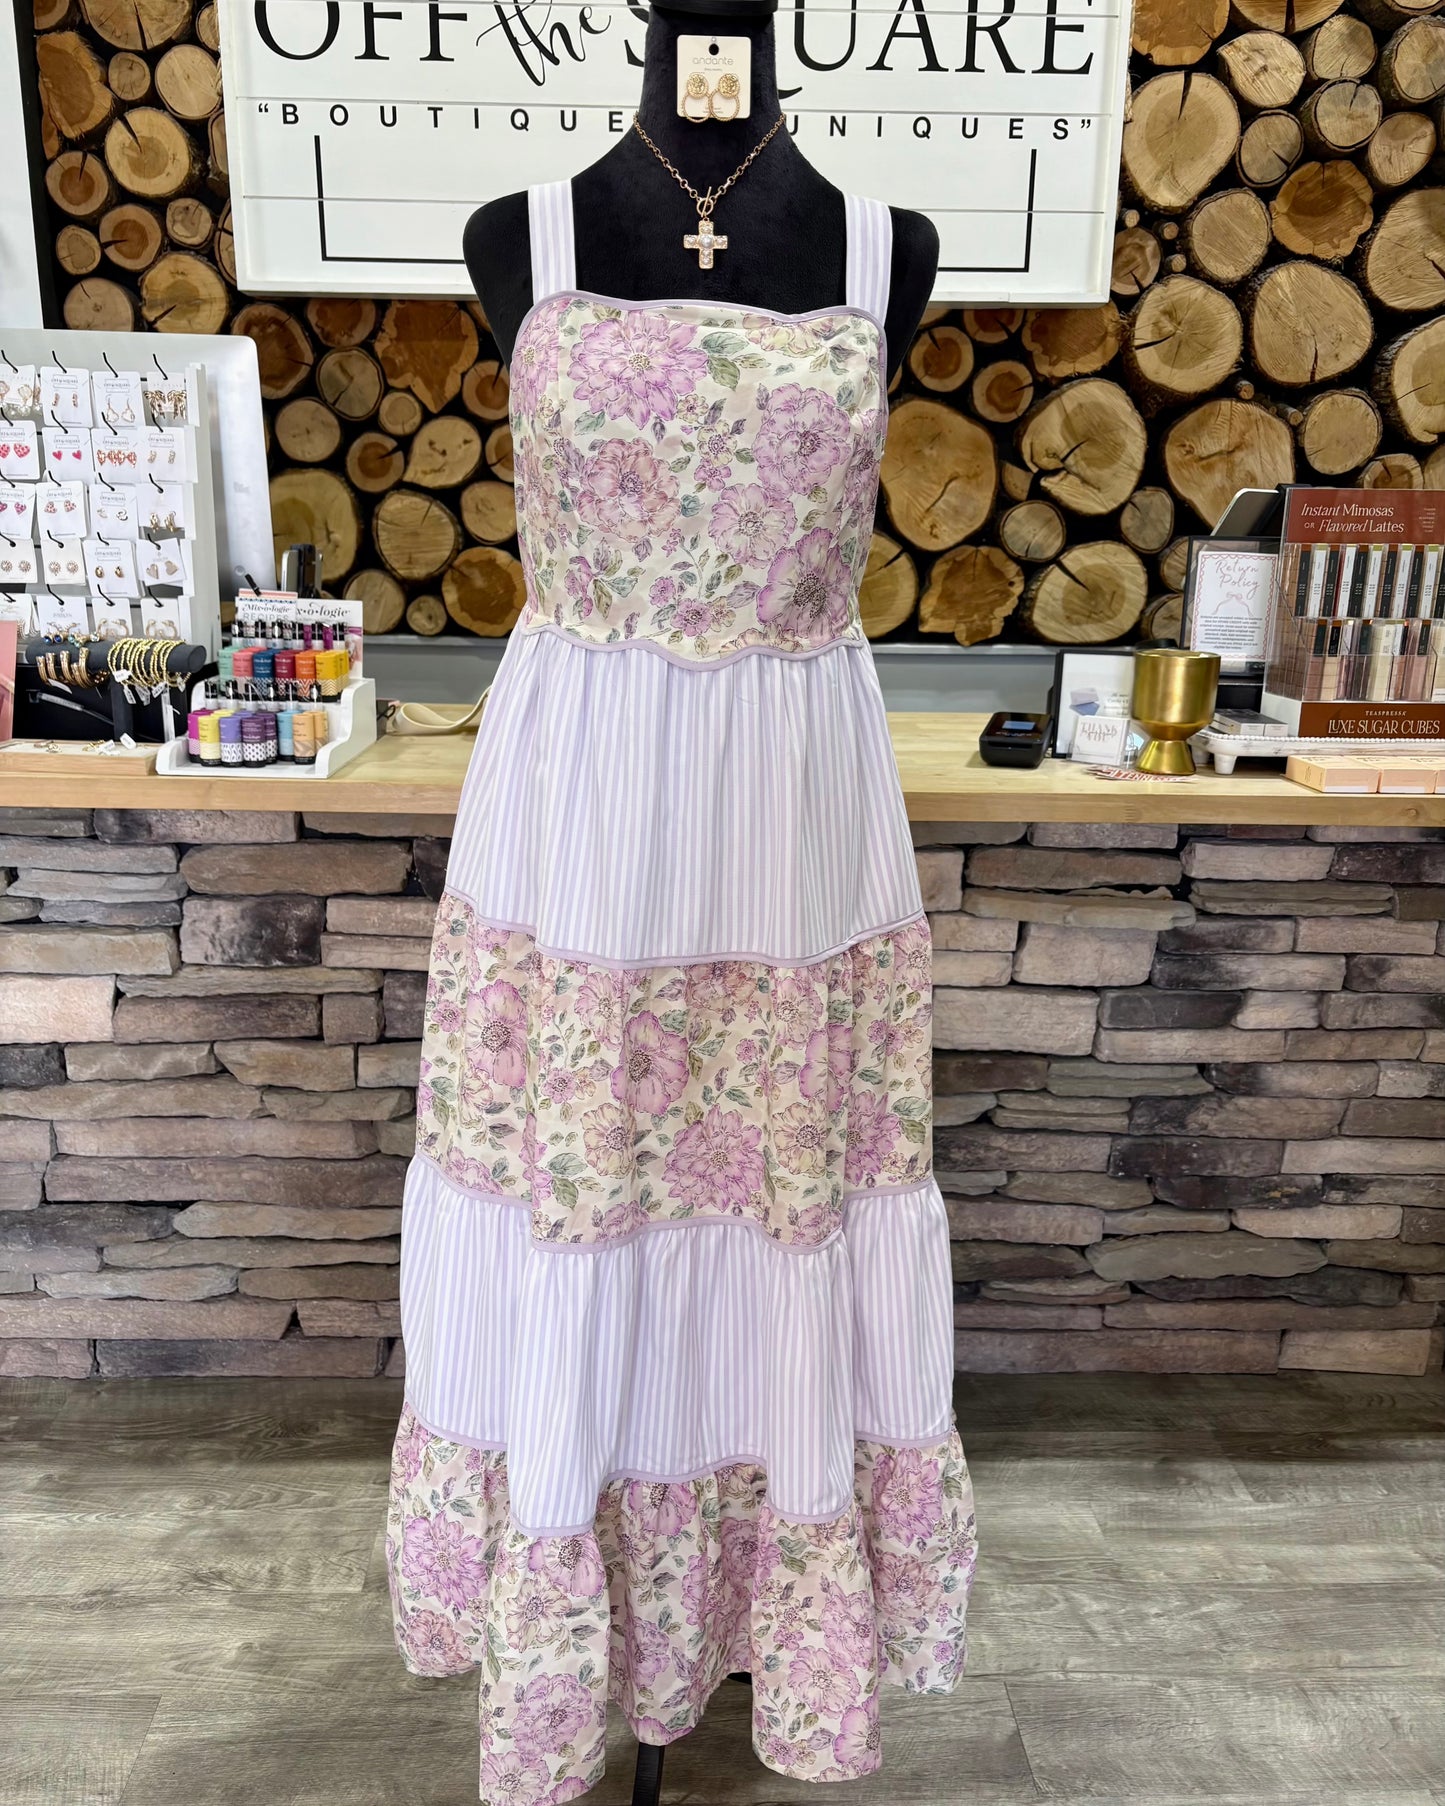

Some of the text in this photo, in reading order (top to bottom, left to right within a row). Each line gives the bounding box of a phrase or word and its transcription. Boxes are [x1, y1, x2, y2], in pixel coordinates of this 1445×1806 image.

[254, 0, 468, 61] OFF
[475, 0, 612, 87] the
[691, 56, 734, 66] andante
[1300, 503, 1395, 517] Instant Mimosas
[1303, 521, 1316, 529] OR
[1318, 519, 1369, 532] Flavored
[1369, 519, 1405, 533] Lattes
[1215, 559, 1260, 576] Return
[1219, 573, 1261, 600] Policy
[243, 613, 289, 621] RECIPES
[1327, 719, 1441, 735] LUXE SUGAR CUBES
